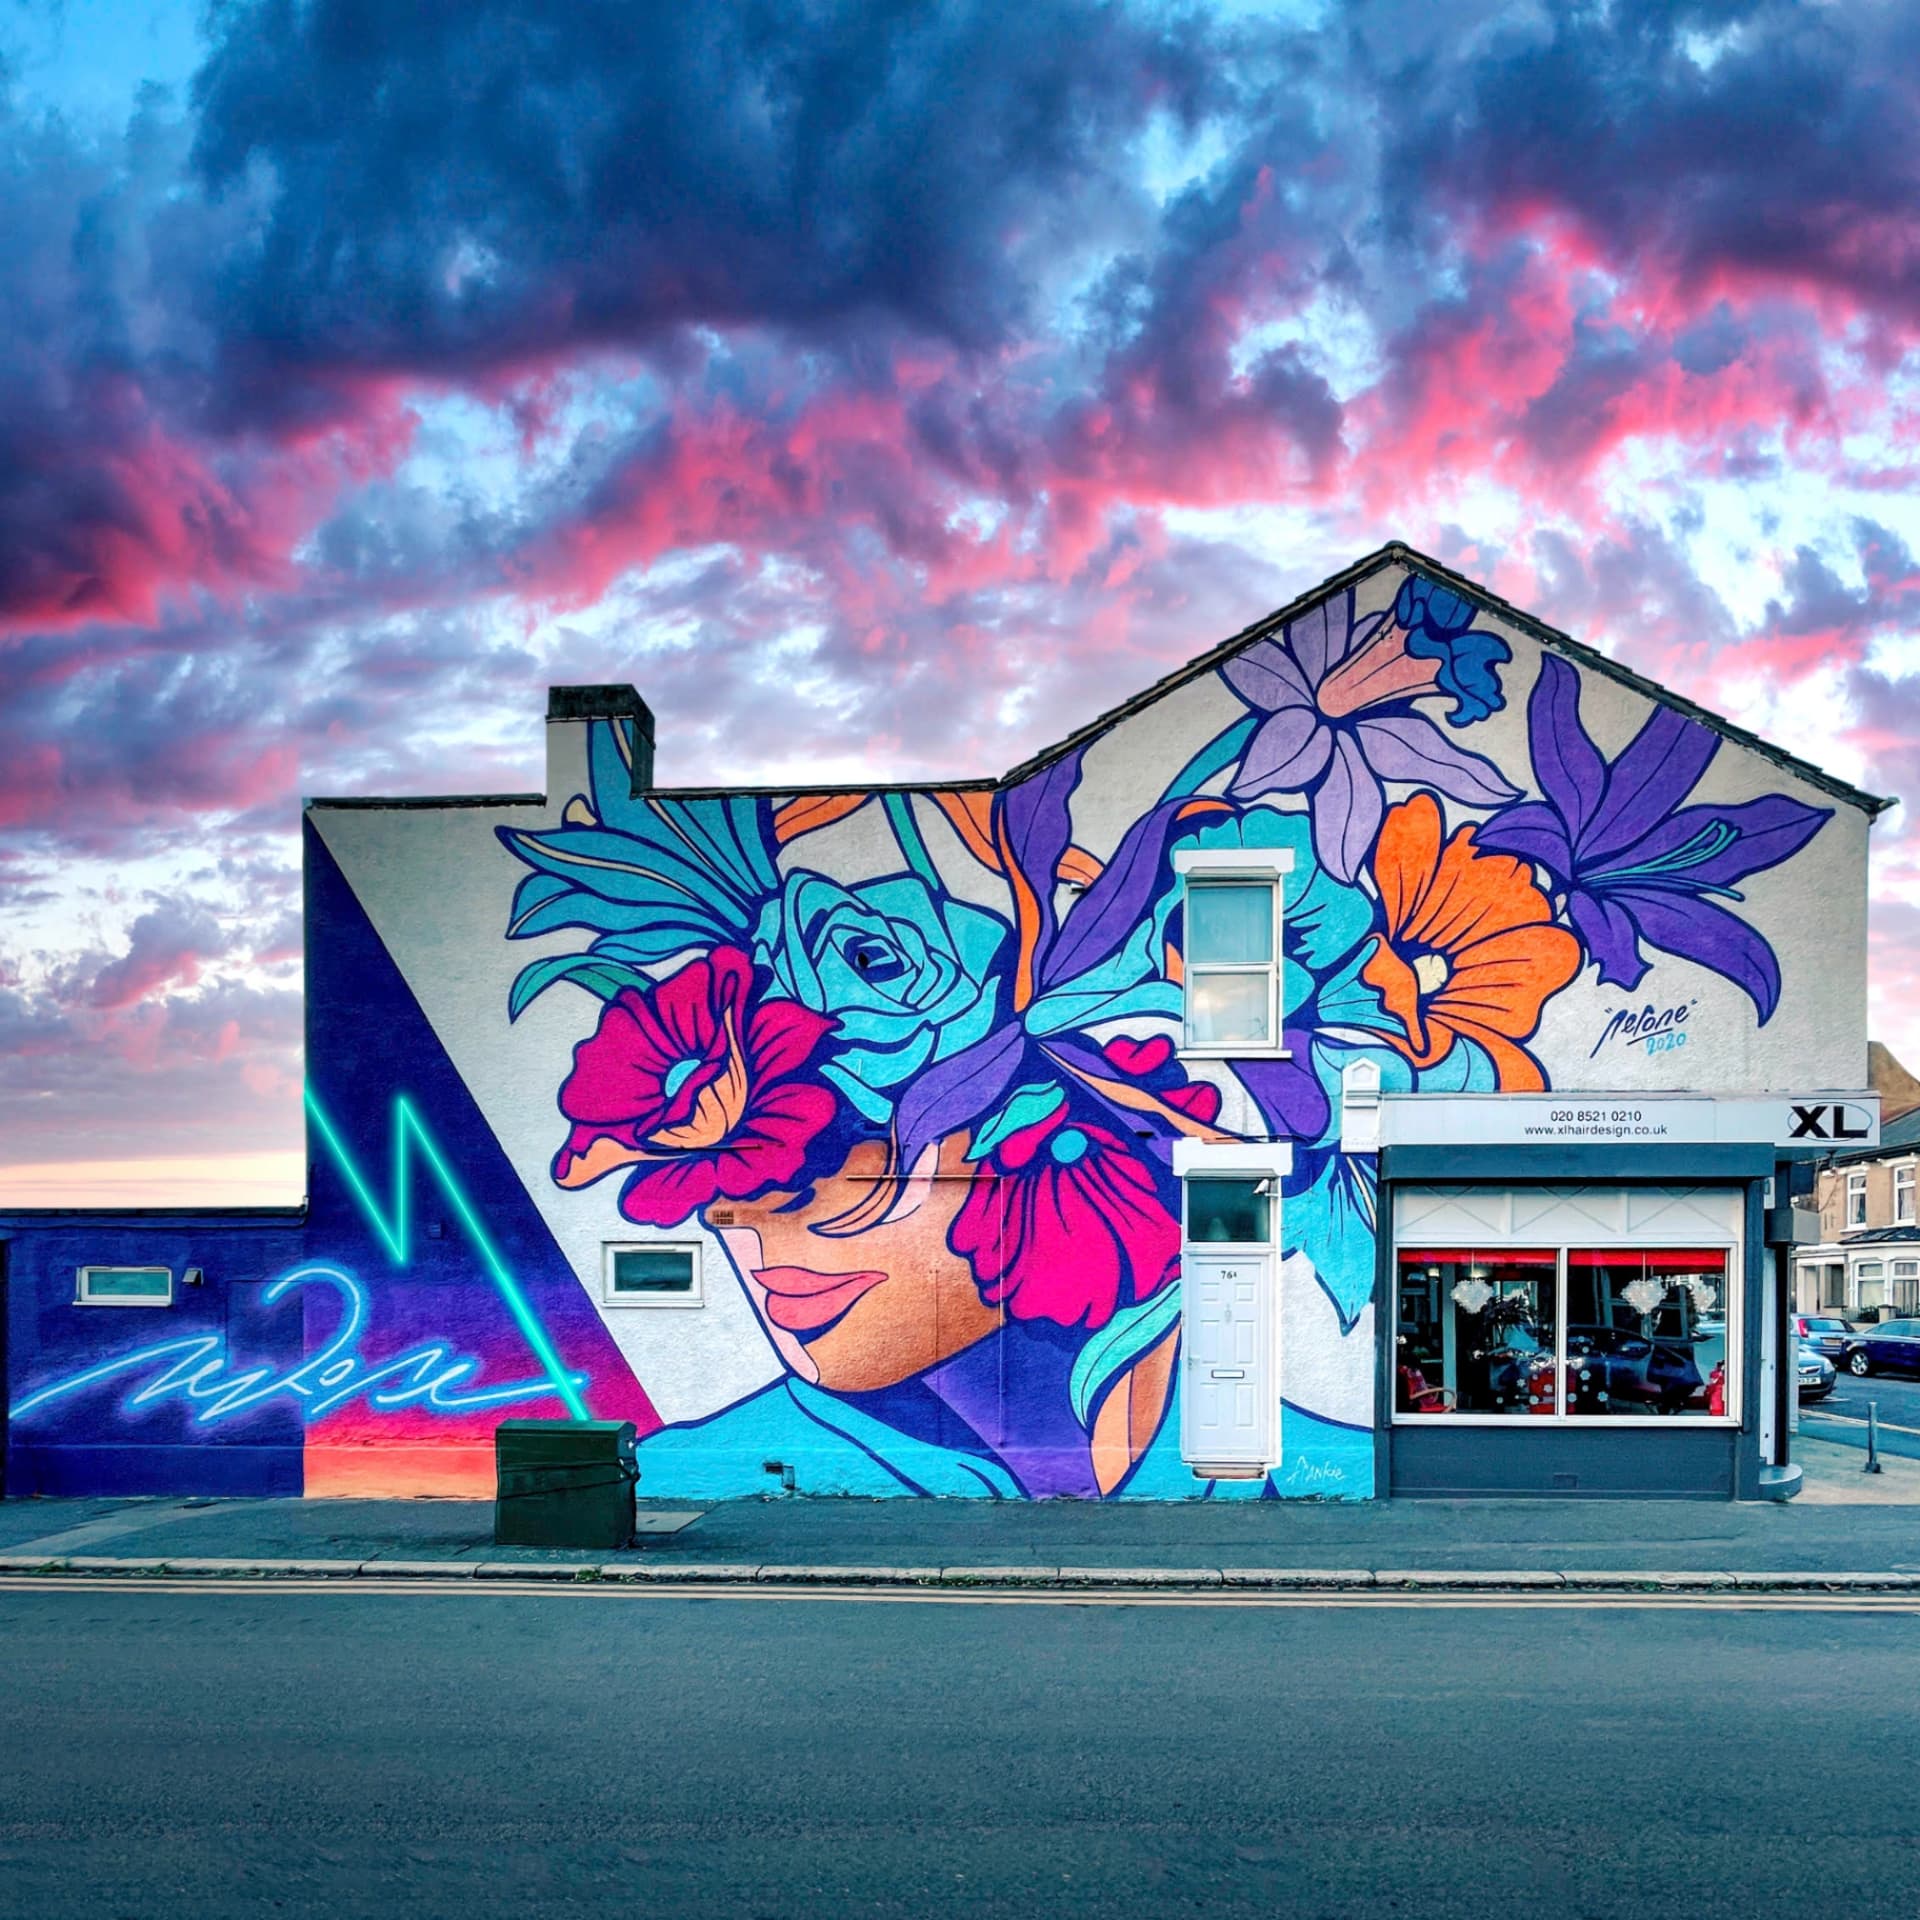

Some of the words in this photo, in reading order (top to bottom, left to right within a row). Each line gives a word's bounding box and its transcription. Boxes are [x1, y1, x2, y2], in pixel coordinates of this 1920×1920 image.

[1646, 1032, 1687, 1056] 2020
[1550, 1110, 1573, 1122] 020
[1577, 1110, 1606, 1122] 8521
[1611, 1110, 1642, 1122] 0210
[1789, 1105, 1868, 1138] XL
[1524, 1124, 1668, 1138] www.xlhairdesign.co.uk
